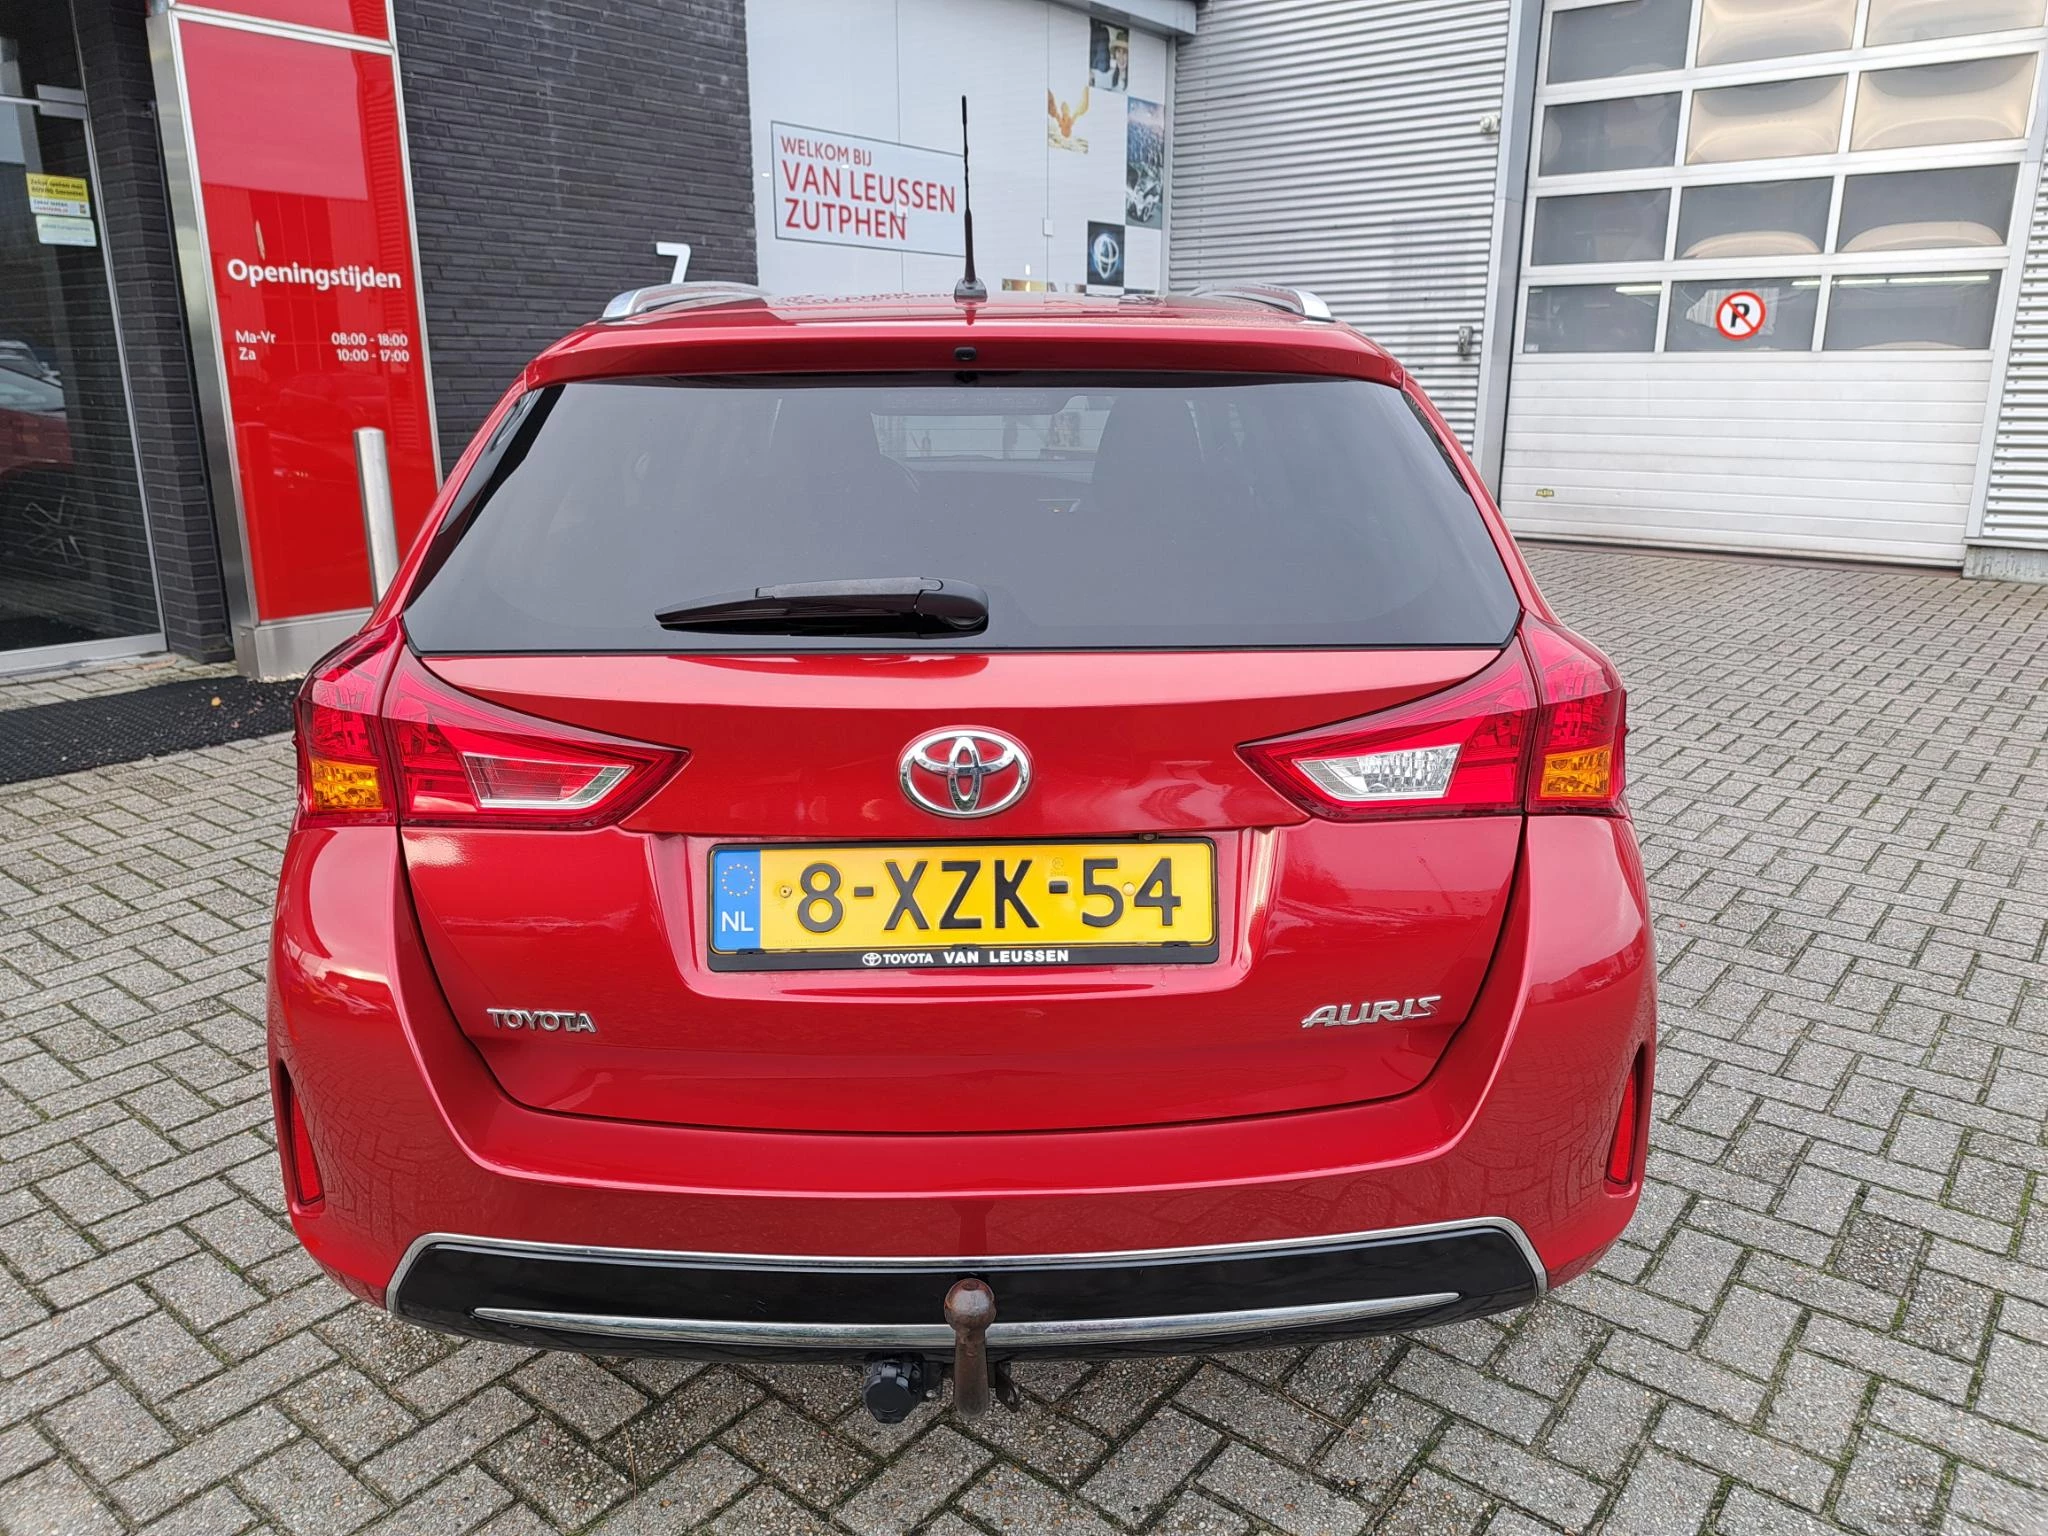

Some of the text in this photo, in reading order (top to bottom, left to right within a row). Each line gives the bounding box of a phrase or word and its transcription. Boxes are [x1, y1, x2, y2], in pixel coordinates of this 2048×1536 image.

[780, 136, 872, 167] WELKOM BIJ
[782, 160, 956, 214] VAN LEUSSEN
[785, 198, 906, 240] ZUTPHEN
[227, 258, 402, 293] Openingstijden
[656, 241, 691, 284] 7
[1730, 303, 1751, 328] P
[235, 330, 277, 344] Ma-Vr
[331, 332, 367, 346] 08:00
[378, 333, 408, 347] 18:00
[239, 346, 257, 361] Za
[336, 348, 369, 362] 10:00
[380, 349, 410, 363] 17:00
[797, 857, 1182, 934] 8-XZK-54
[721, 910, 754, 932] NL
[883, 950, 1069, 965] TOYOTA VAN LEUSSEN
[486, 1008, 597, 1033] TOYOTA
[1301, 995, 1442, 1028] AURIS
